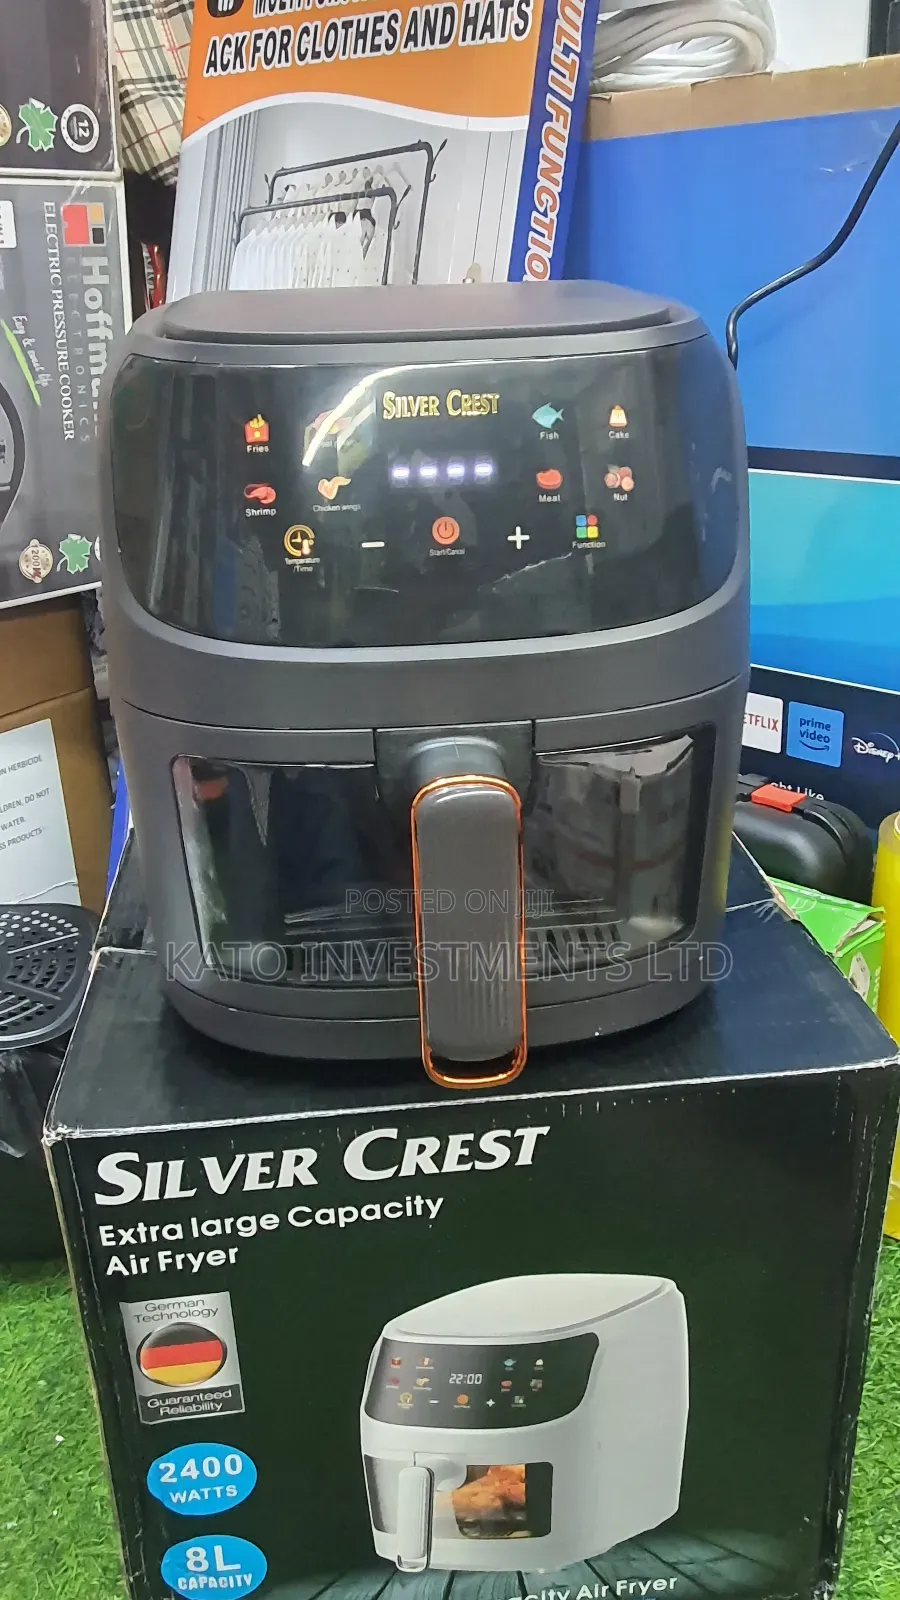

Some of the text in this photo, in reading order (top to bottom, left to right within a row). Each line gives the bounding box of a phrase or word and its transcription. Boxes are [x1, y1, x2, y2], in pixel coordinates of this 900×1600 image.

[205, 0, 532, 75] ACK FOR CLOTHES AND HATS
[78, 118, 90, 138] 12
[525, 0, 586, 281] ULTI FUNCTIO
[44, 201, 76, 442] ELECTRIC PRESSURE COOKER
[82, 256, 113, 432] Hoffm
[382, 388, 500, 420] SILVER CREST
[539, 431, 560, 440] Fish
[608, 430, 630, 440] Cake
[246, 445, 270, 454] Fries
[613, 492, 629, 502] Nut
[245, 508, 277, 517] Shrimp
[312, 504, 341, 512] Chicken
[572, 540, 606, 549] Function
[742, 712, 779, 733] ETFLIX
[799, 717, 832, 732] prime
[799, 729, 831, 744] video
[8, 754, 43, 772] HERBICIDE
[0, 787, 50, 814] LDREN, DO NOT
[7, 827, 43, 846] PRODUCTS
[94, 1125, 551, 1206] SILVER CREST
[99, 1195, 445, 1248] Extra large Capacity
[105, 1244, 239, 1277] Air Fryer
[133, 1306, 219, 1324] Technology
[145, 1298, 205, 1313] German
[449, 1373, 483, 1385] 22:00
[147, 1389, 233, 1409] Guaranteed
[159, 1401, 223, 1416] Reliability
[158, 1453, 243, 1484] 2400
[169, 1485, 238, 1504] WATTS
[177, 1572, 253, 1591] CAPACITY
[616, 1577, 678, 1596] Fryer
